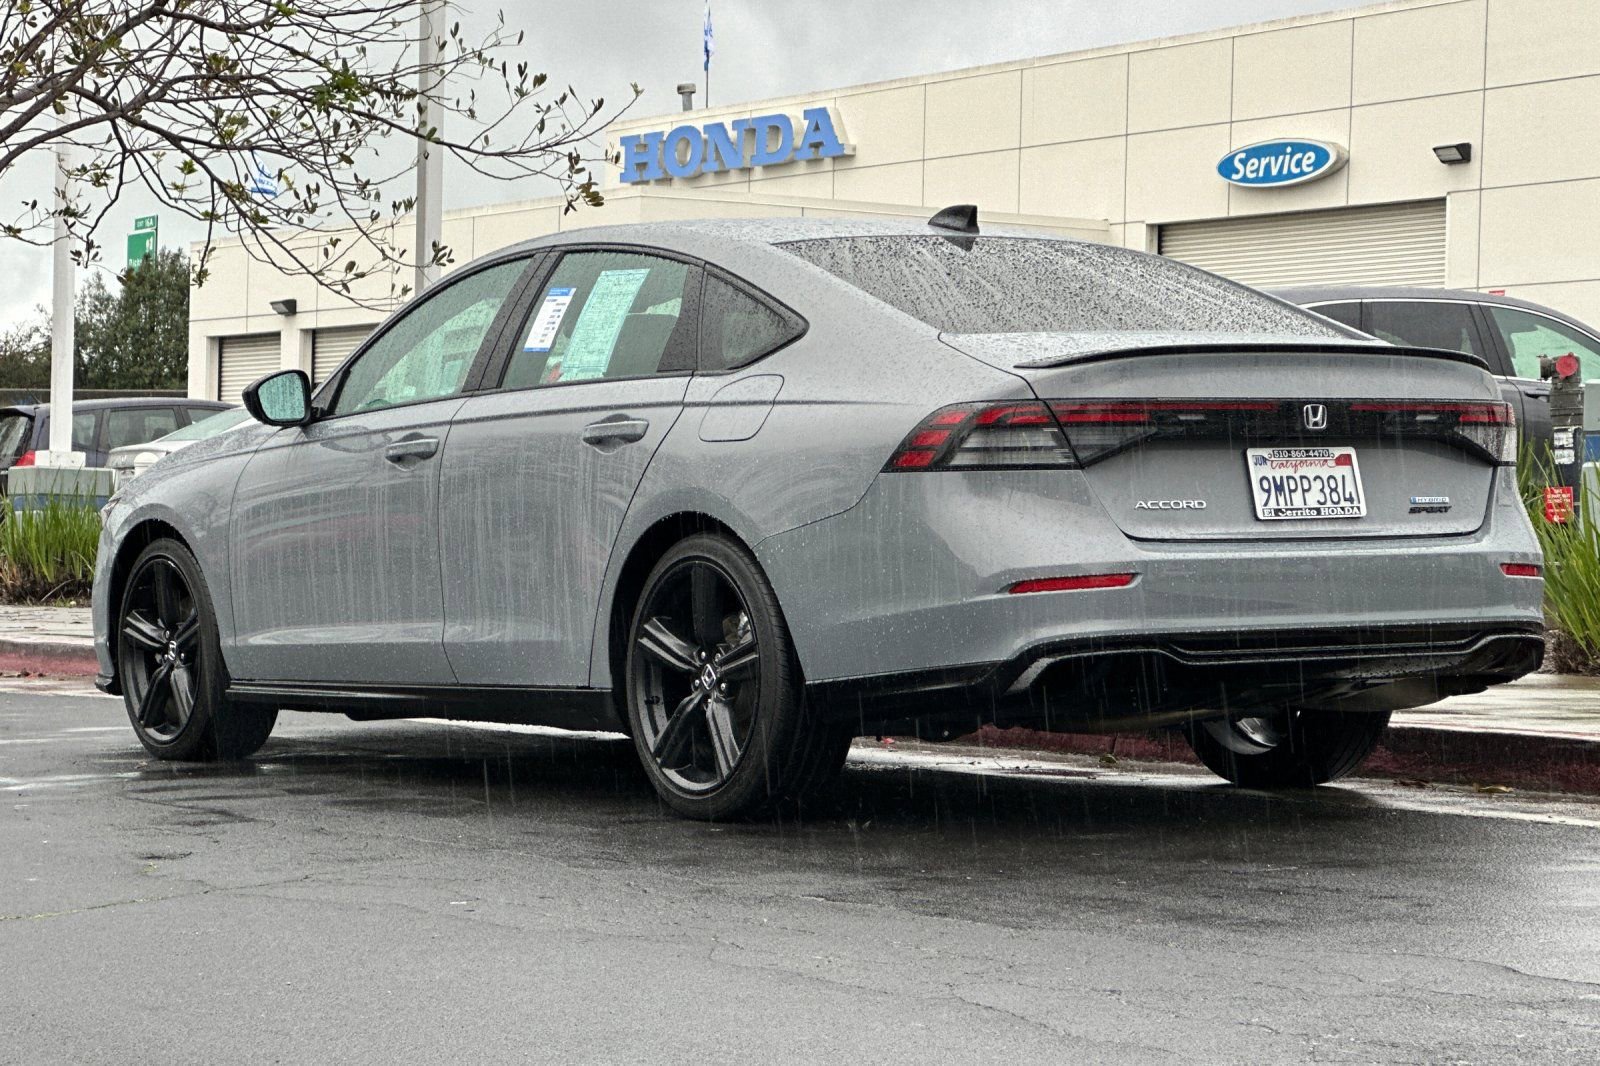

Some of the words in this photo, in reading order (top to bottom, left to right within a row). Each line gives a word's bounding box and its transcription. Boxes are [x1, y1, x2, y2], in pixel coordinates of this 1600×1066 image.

[620, 107, 845, 183] HONDA
[1231, 146, 1316, 180] Service
[1273, 450, 1329, 458] 510-860-4470
[1270, 459, 1329, 473] California
[1259, 474, 1355, 507] 9MPP384
[1135, 500, 1207, 510] ACCORD
[1263, 509, 1275, 517] El
[1320, 507, 1361, 516] HONDA
